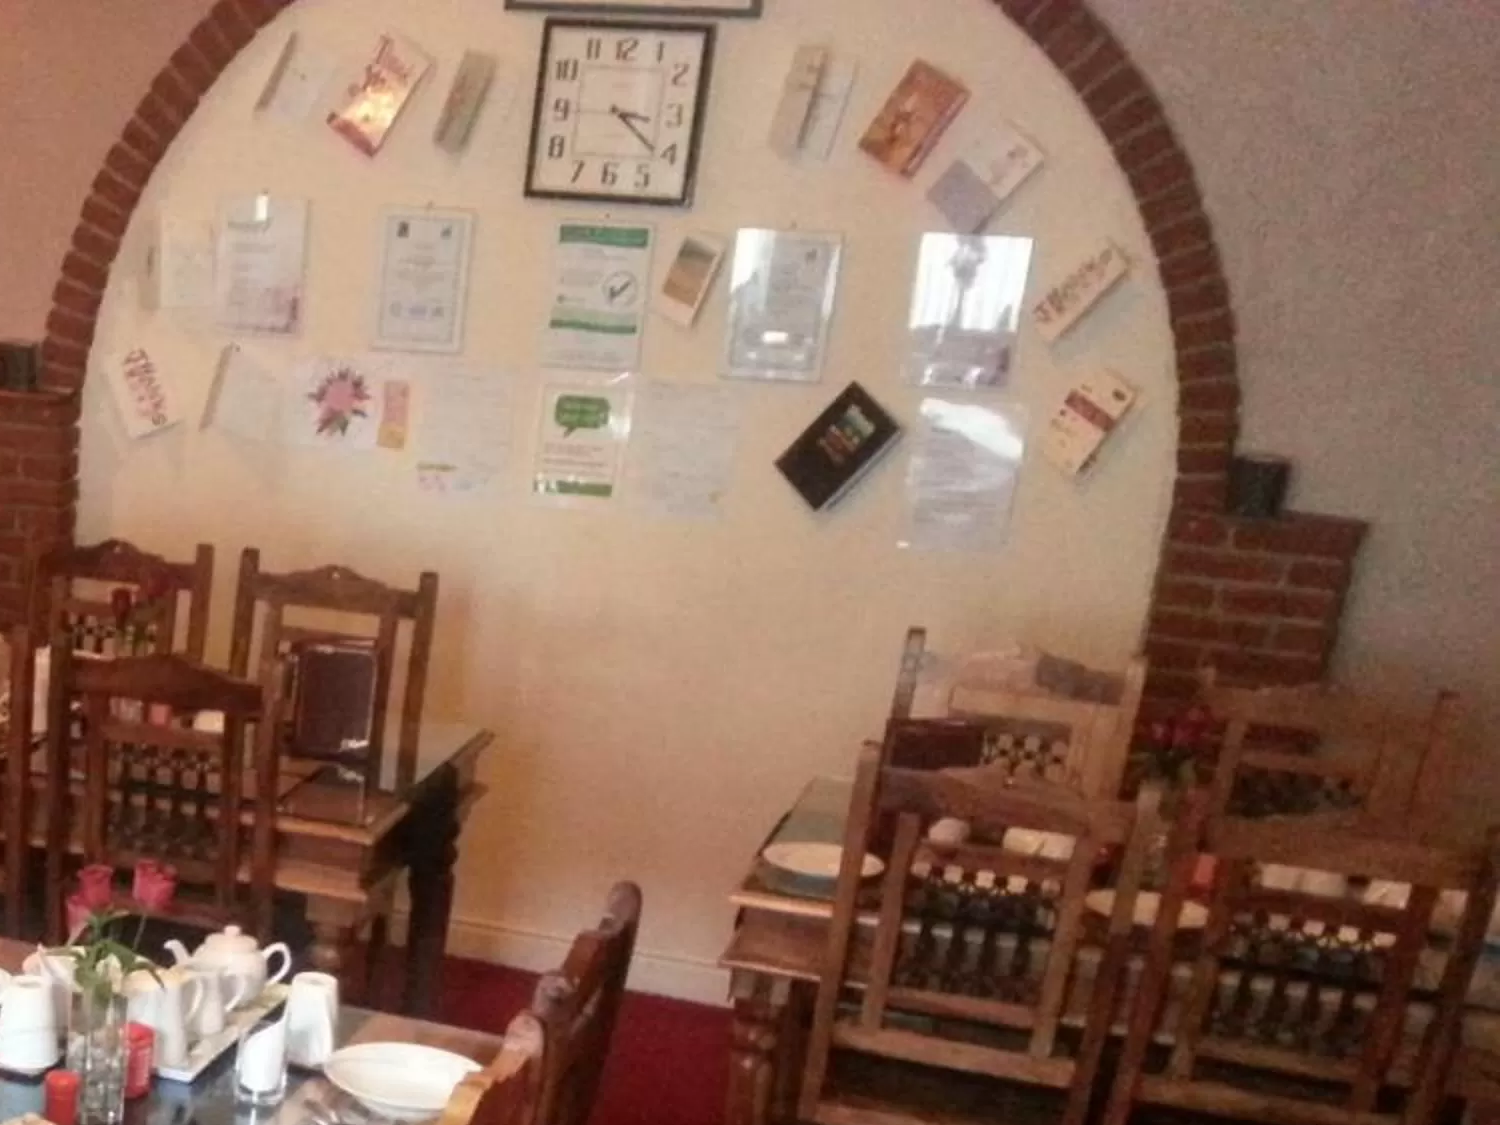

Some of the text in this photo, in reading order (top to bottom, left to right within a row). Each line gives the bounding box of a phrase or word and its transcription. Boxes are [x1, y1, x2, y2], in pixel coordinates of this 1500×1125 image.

[586, 38, 601, 60] 11
[615, 37, 639, 61] 12
[656, 41, 665, 63] 1
[555, 59, 579, 81] 10
[671, 63, 690, 87] 2
[553, 98, 570, 121] 9
[665, 103, 683, 128] 3
[548, 135, 565, 158] 8
[660, 142, 677, 165] 4
[571, 160, 585, 183] 7
[601, 162, 619, 185] 6
[633, 164, 650, 188] 5
